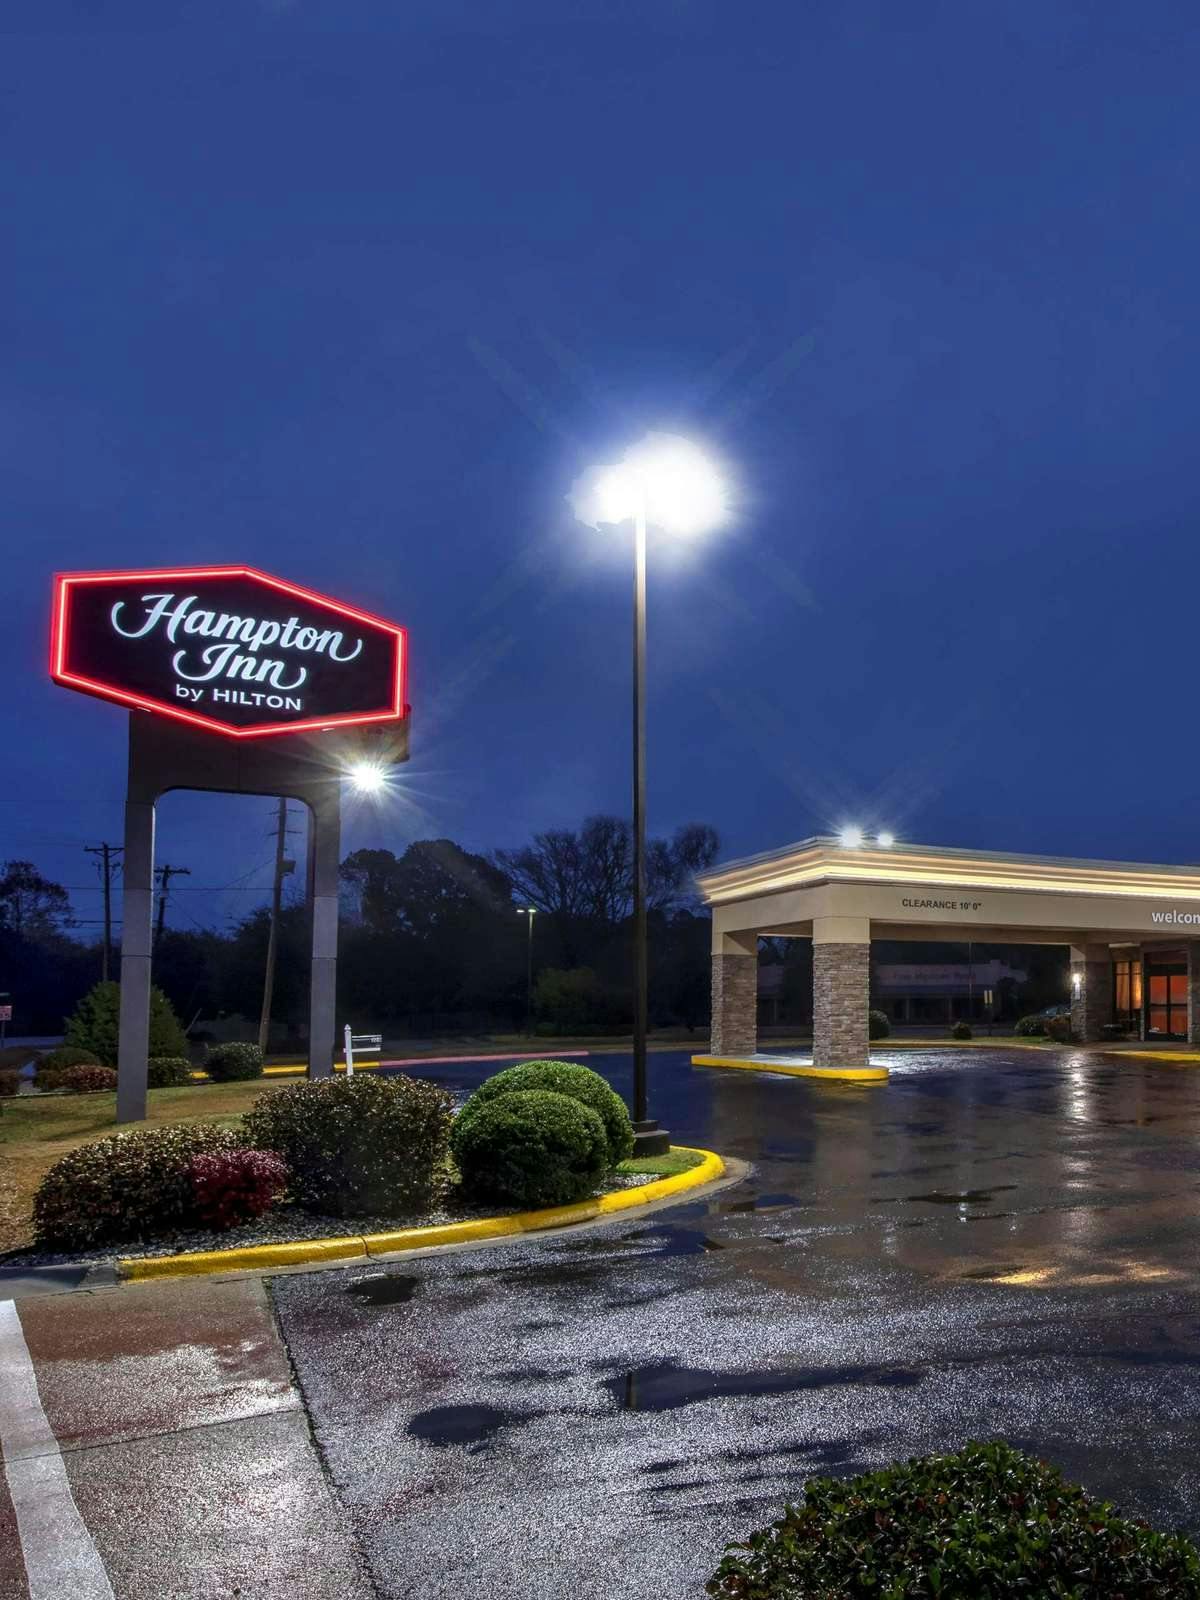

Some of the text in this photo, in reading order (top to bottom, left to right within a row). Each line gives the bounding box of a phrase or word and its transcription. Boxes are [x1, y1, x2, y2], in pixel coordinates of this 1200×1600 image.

[111, 594, 363, 662] Hampton
[173, 643, 307, 690] Inn
[175, 684, 301, 711] by HILTON
[902, 899, 957, 909] CLEARANCE
